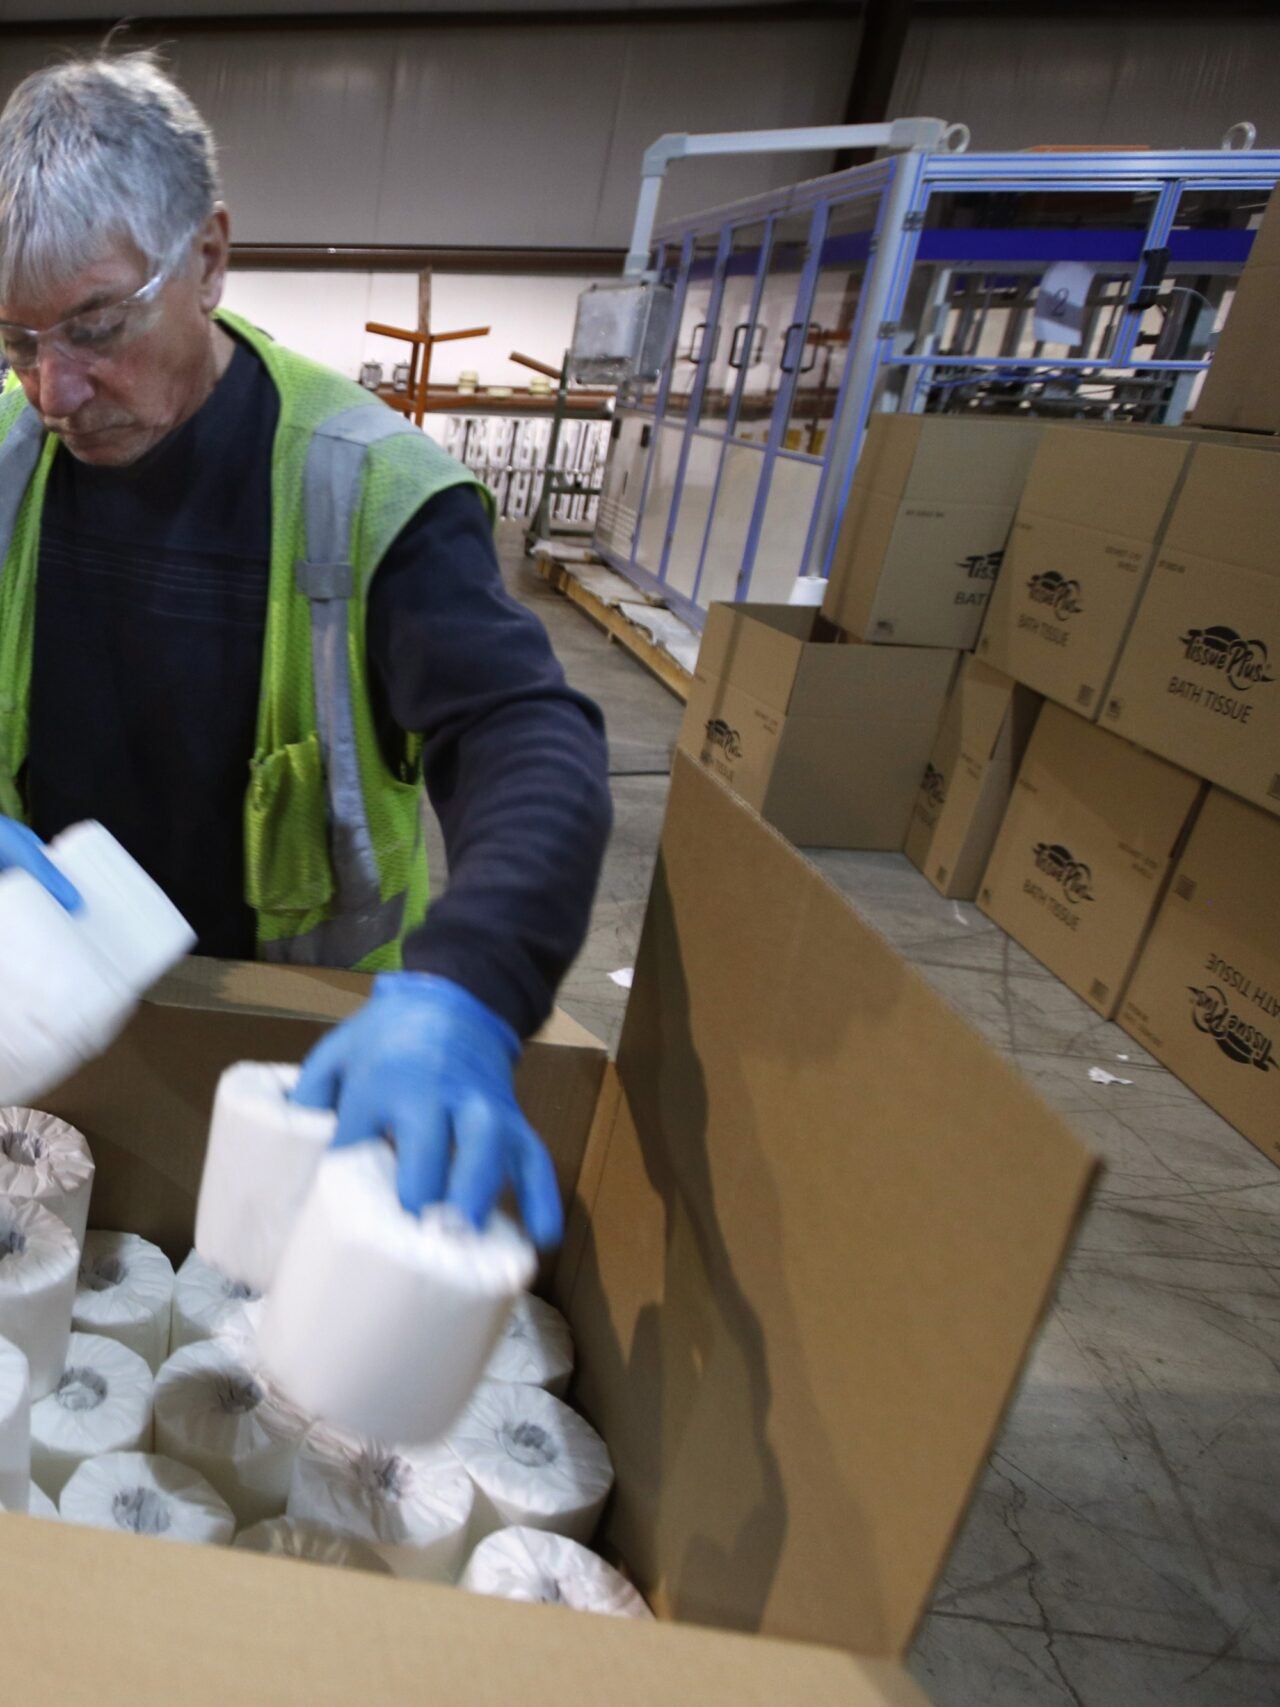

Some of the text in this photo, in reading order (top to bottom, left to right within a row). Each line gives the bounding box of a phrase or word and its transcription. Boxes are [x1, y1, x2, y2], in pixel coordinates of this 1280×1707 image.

[1179, 629, 1227, 670] Tissue
[1168, 676, 1254, 724] BATH TISSUE
[1204, 952, 1252, 998] TISSUE
